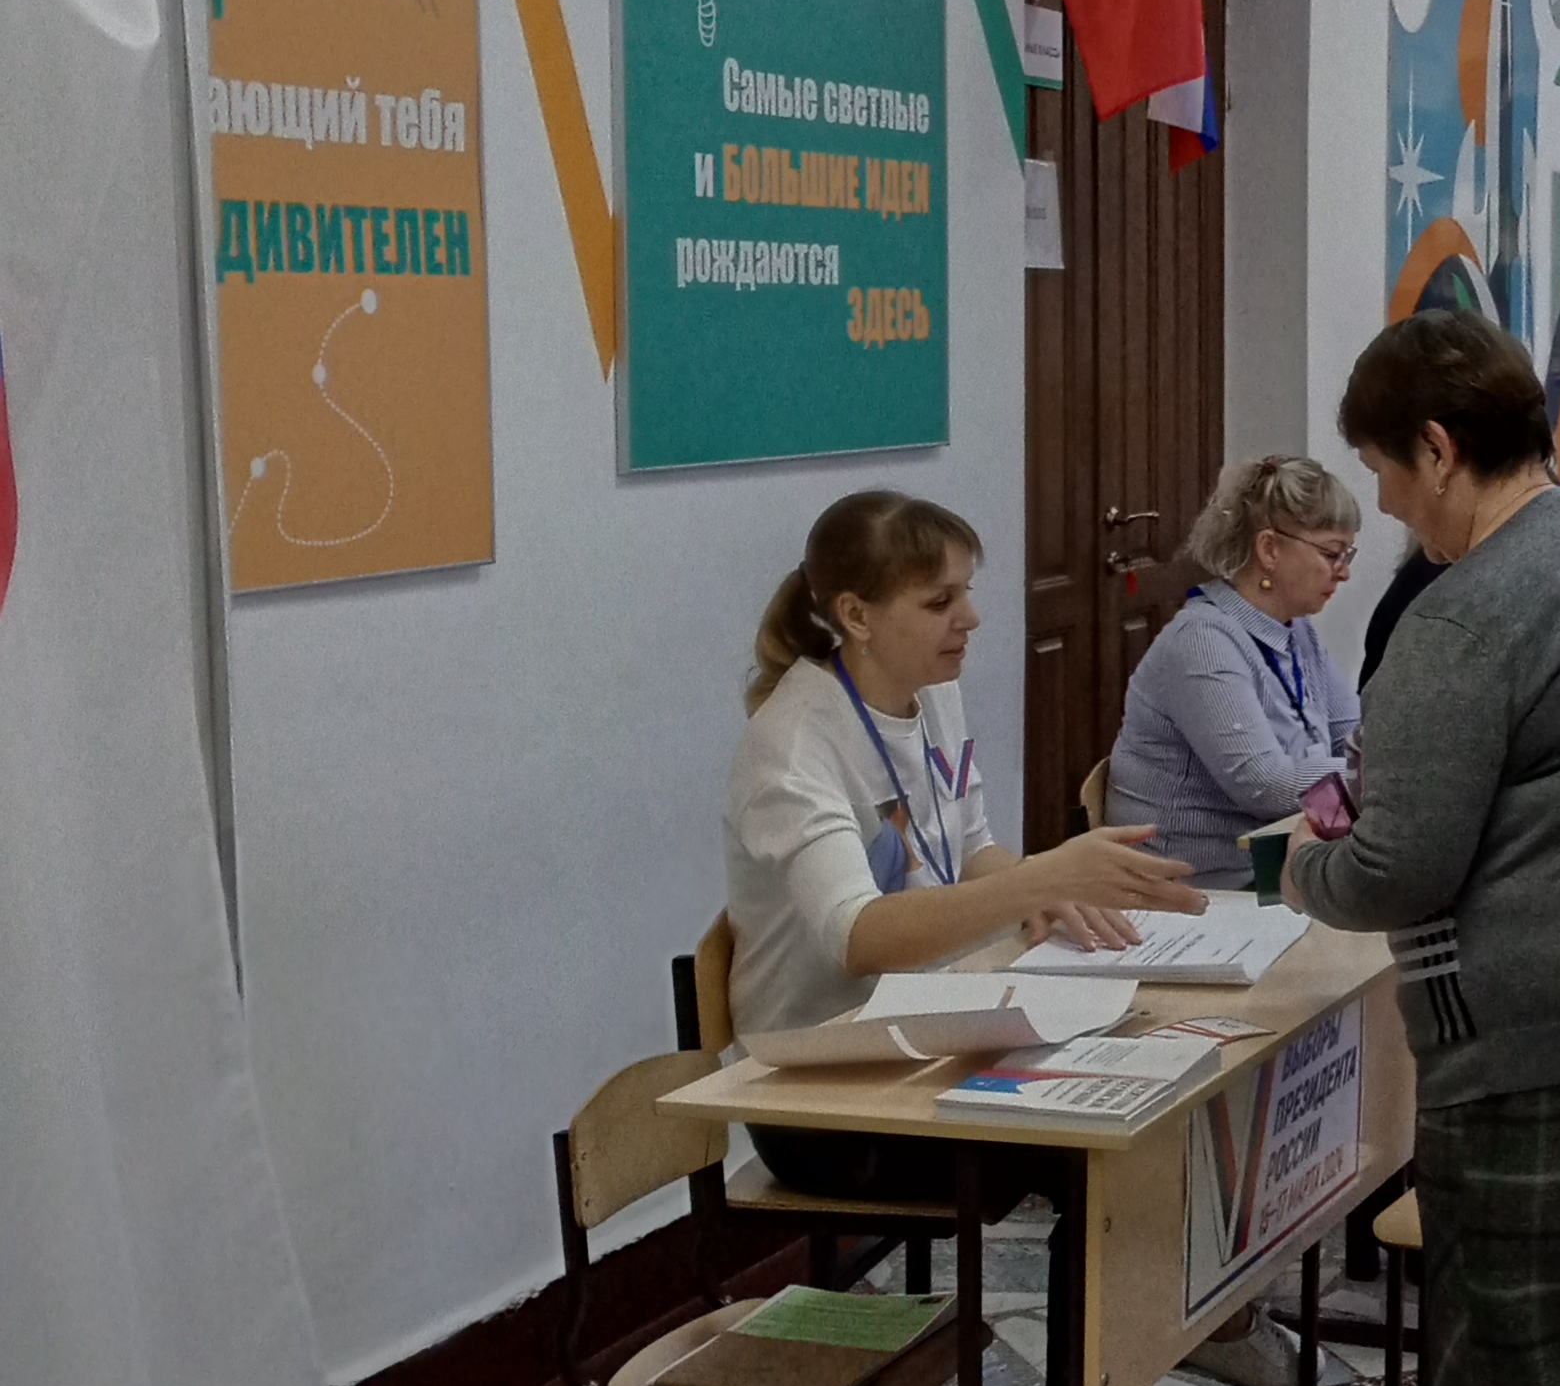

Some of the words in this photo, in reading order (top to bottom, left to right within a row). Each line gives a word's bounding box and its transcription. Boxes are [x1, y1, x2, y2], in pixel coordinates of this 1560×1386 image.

[206, 76, 368, 151] ающий
[374, 88, 465, 153] тебя
[723, 57, 818, 121] Самые
[823, 81, 930, 134] светлые
[723, 144, 861, 210] БОЛЬШИЕ
[866, 157, 931, 221] ИДЕИ
[215, 198, 472, 284] ДИВИТЕЛЕН
[676, 237, 840, 292] рождаются
[847, 287, 931, 350] ЗДЕСЬ
[1281, 1012, 1342, 1083] ВЫБОРЫ
[1273, 1045, 1358, 1136] ПРЕЗИДЕНТА
[1265, 1116, 1322, 1191] РОССИИ
